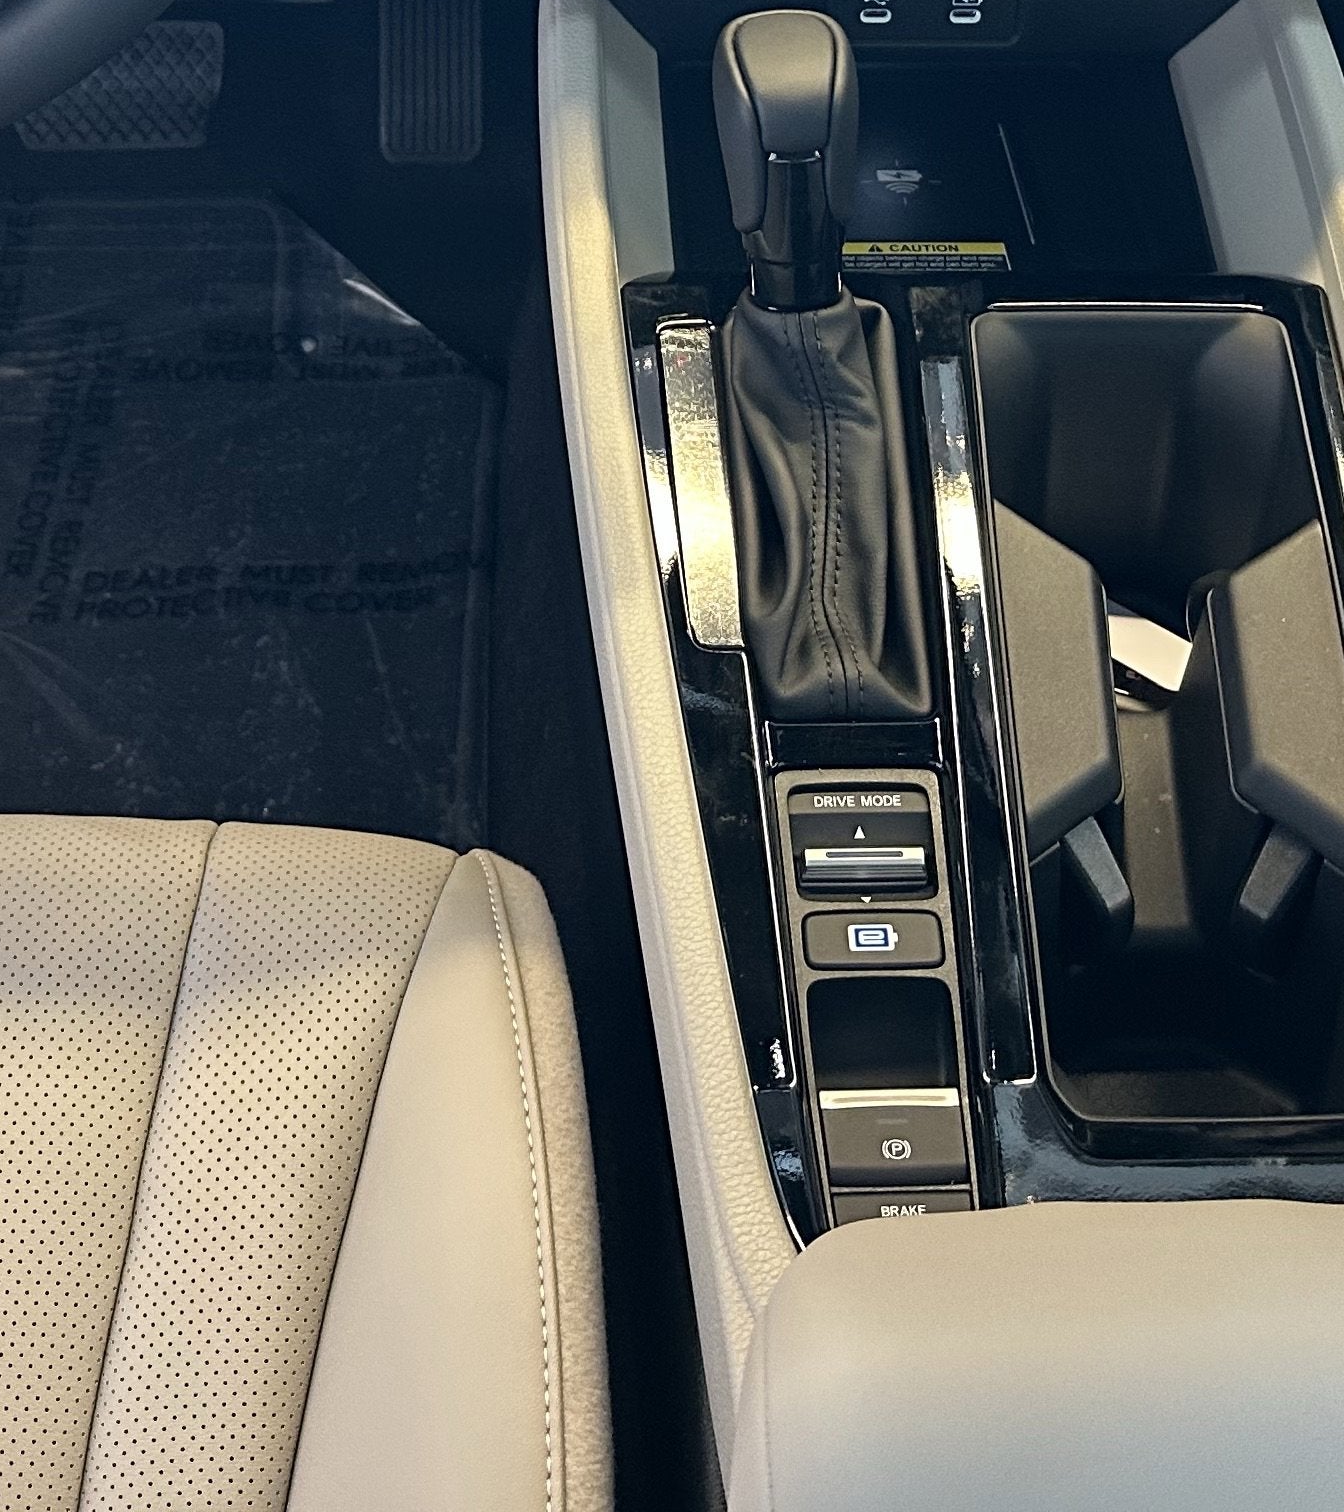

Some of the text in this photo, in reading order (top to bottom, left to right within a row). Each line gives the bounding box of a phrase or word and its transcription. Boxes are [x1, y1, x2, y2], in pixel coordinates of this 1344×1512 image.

[889, 244, 960, 253] CAUTION
[83, 565, 219, 595] DEALER
[240, 562, 334, 586] MUST
[813, 794, 902, 808] DRIVE MODE
[880, 1203, 927, 1218] BRAKE
